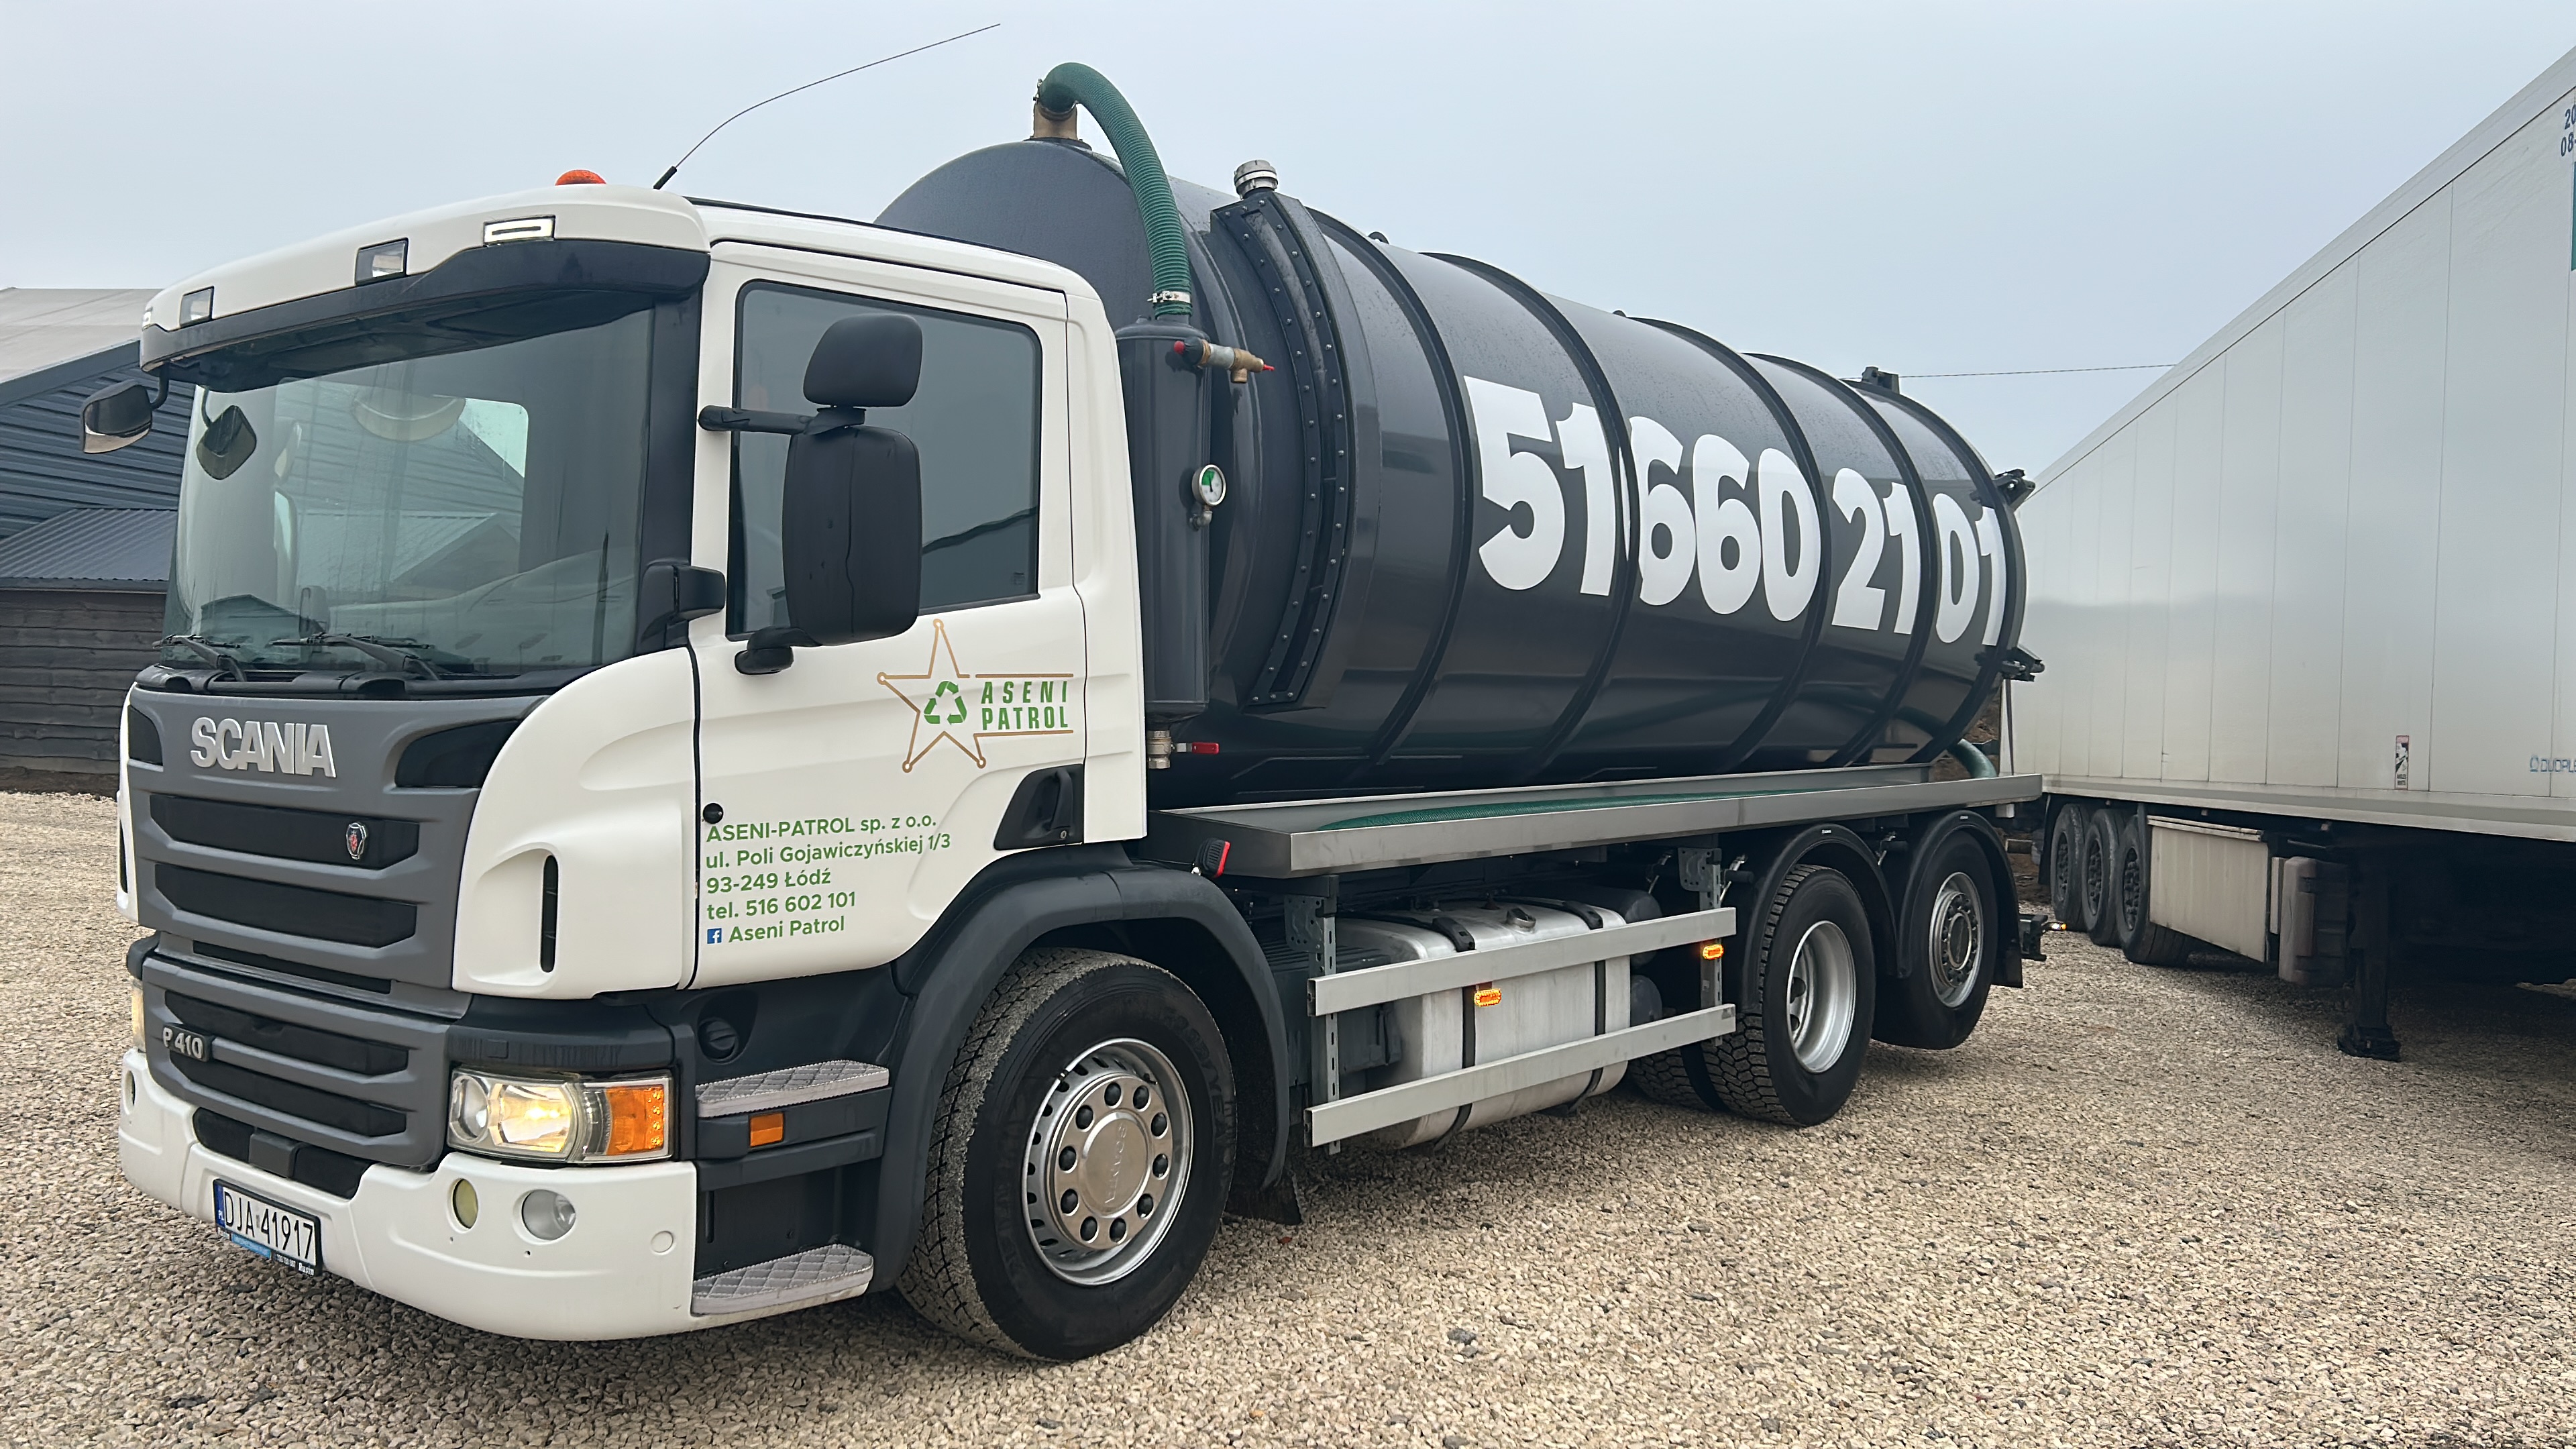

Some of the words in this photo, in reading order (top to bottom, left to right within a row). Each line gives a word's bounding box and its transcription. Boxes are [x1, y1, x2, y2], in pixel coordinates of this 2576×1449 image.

[981, 681, 1068, 704] ASENI
[982, 706, 1068, 731] PATROL
[191, 717, 336, 777] SCANIA
[707, 818, 855, 842] ASENI-PATROL
[861, 818, 885, 834] sp.
[892, 817, 900, 829] z
[906, 815, 936, 828] o.o.
[706, 852, 729, 869] ul.
[737, 848, 773, 865] Poli
[780, 835, 923, 863] Gojawiczyńskiej
[928, 833, 951, 851] 1/3
[706, 873, 778, 894] 93-249
[784, 867, 830, 887] Łódź
[707, 902, 739, 920] tel.
[746, 898, 778, 916] 516
[785, 895, 822, 912] 602
[828, 892, 855, 908] 101
[729, 922, 784, 942] Aseni
[790, 916, 845, 935] Patrol
[163, 1027, 173, 1047] P
[175, 1033, 203, 1059] 410
[224, 1191, 255, 1238] DJA
[261, 1209, 313, 1259] 41917
